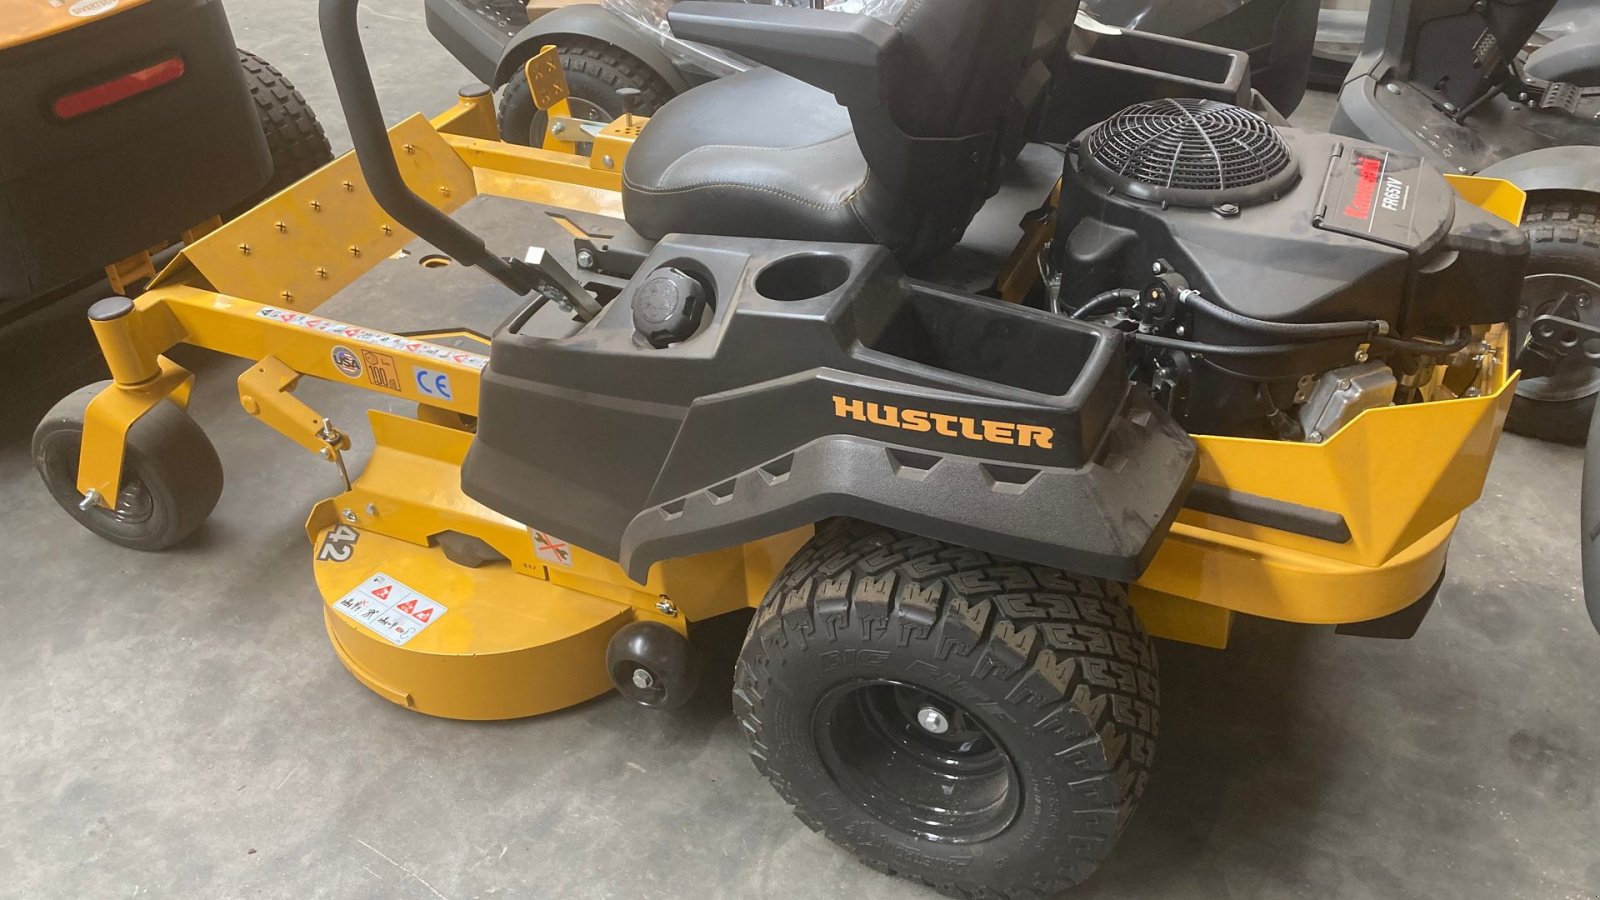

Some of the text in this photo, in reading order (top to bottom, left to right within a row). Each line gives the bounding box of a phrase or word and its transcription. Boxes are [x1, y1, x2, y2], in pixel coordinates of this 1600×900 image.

[1382, 176, 1403, 211] FR651V
[333, 354, 361, 370] USA
[369, 365, 389, 387] 100
[417, 370, 451, 398] CE
[832, 395, 1054, 449] HUSTLER
[318, 524, 358, 562] 42
[819, 649, 891, 673] BIG
